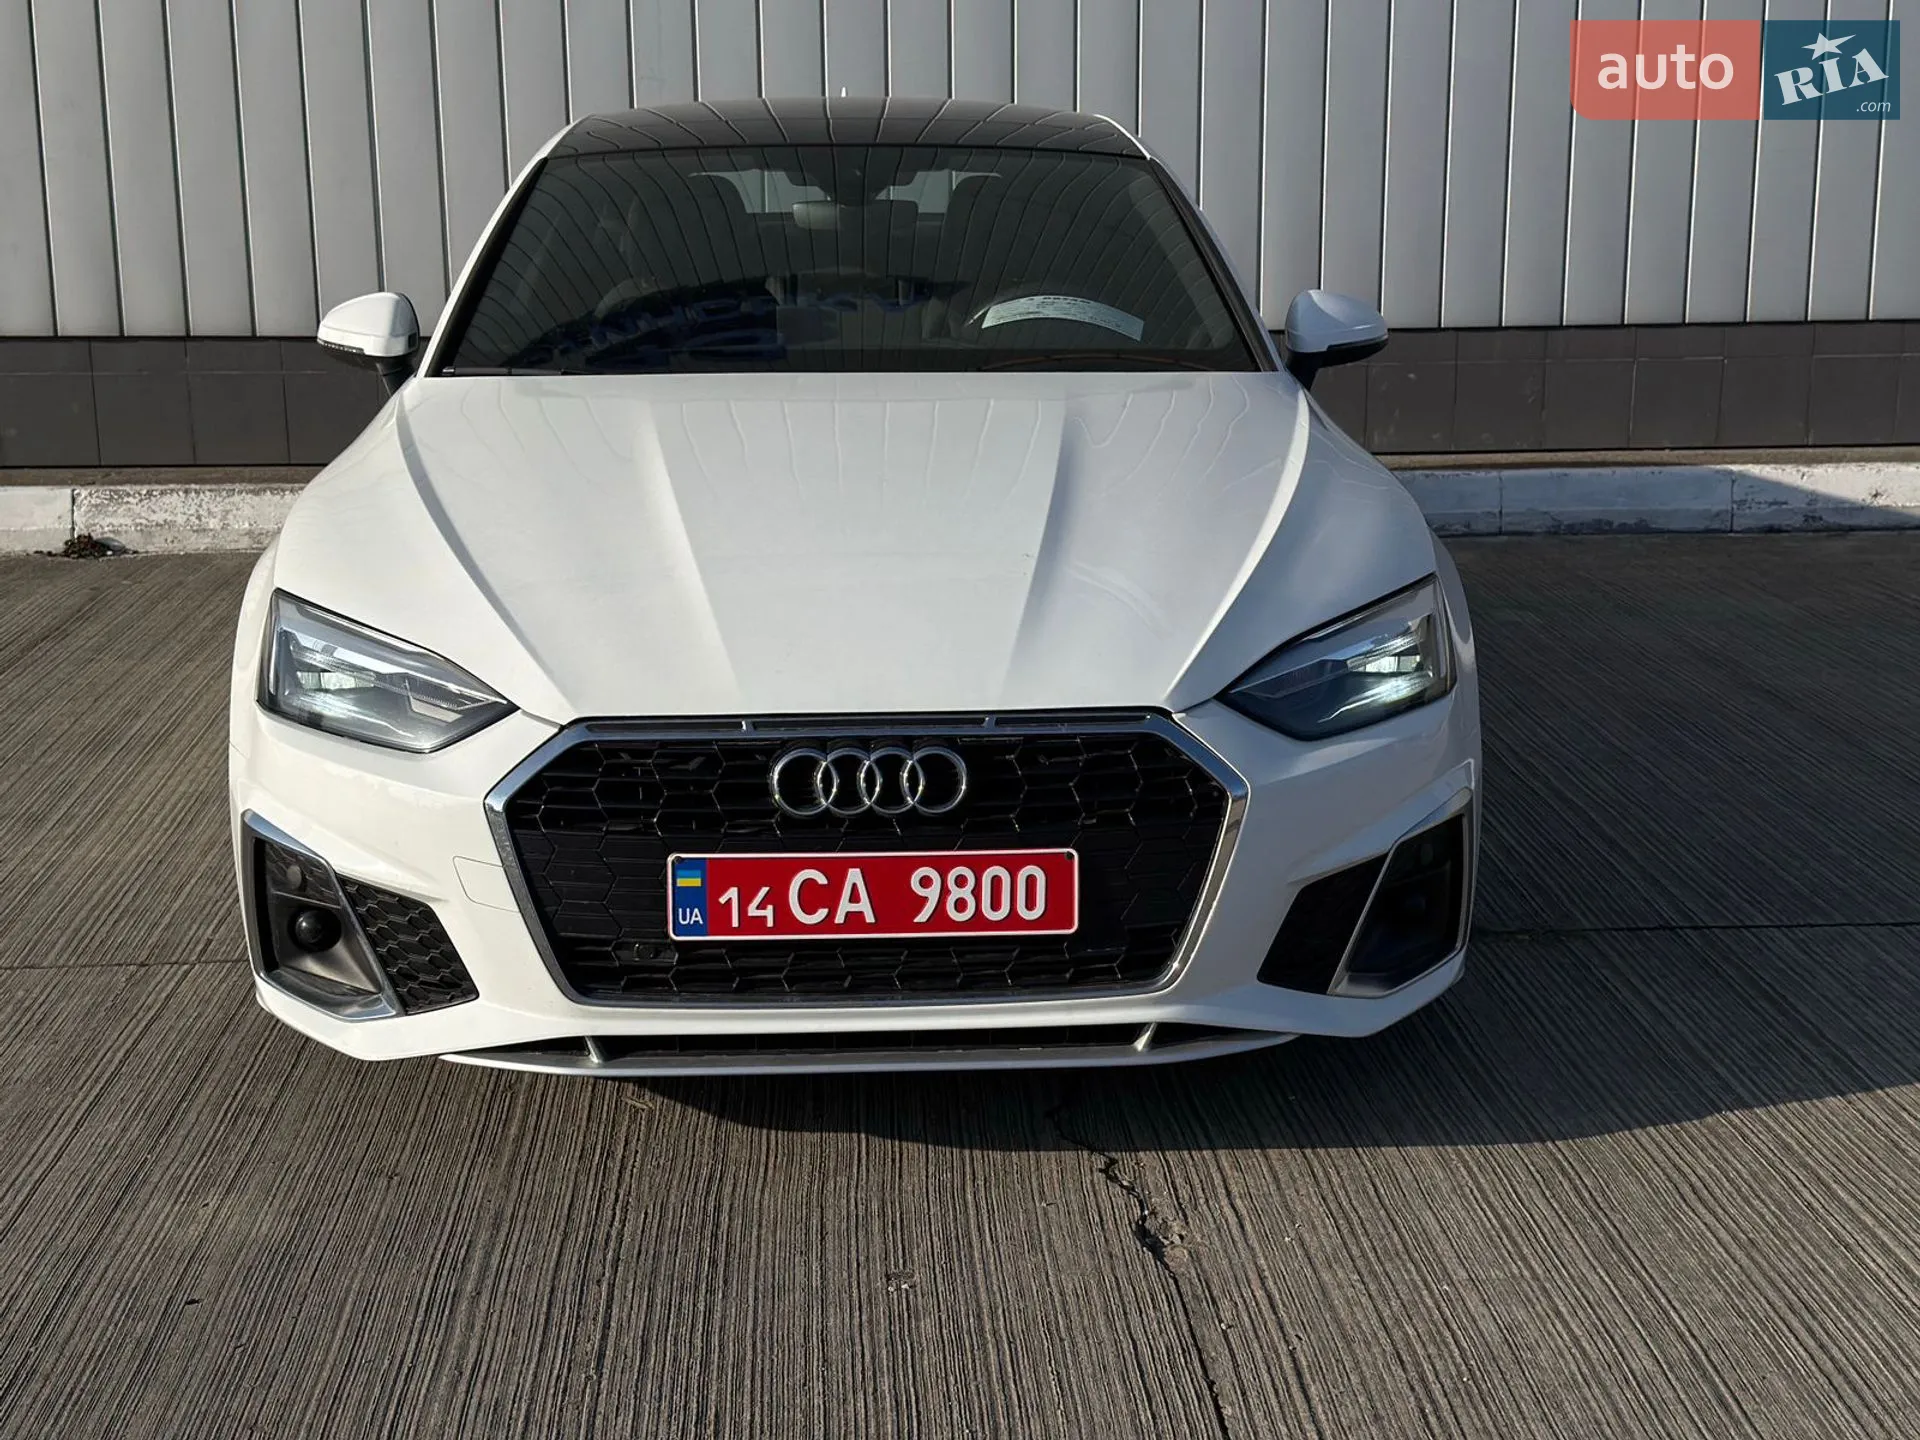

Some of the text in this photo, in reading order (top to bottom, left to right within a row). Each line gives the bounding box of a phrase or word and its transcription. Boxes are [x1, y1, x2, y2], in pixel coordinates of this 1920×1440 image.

[718, 865, 1047, 928] 14 CA 9800
[678, 908, 703, 926] UA
